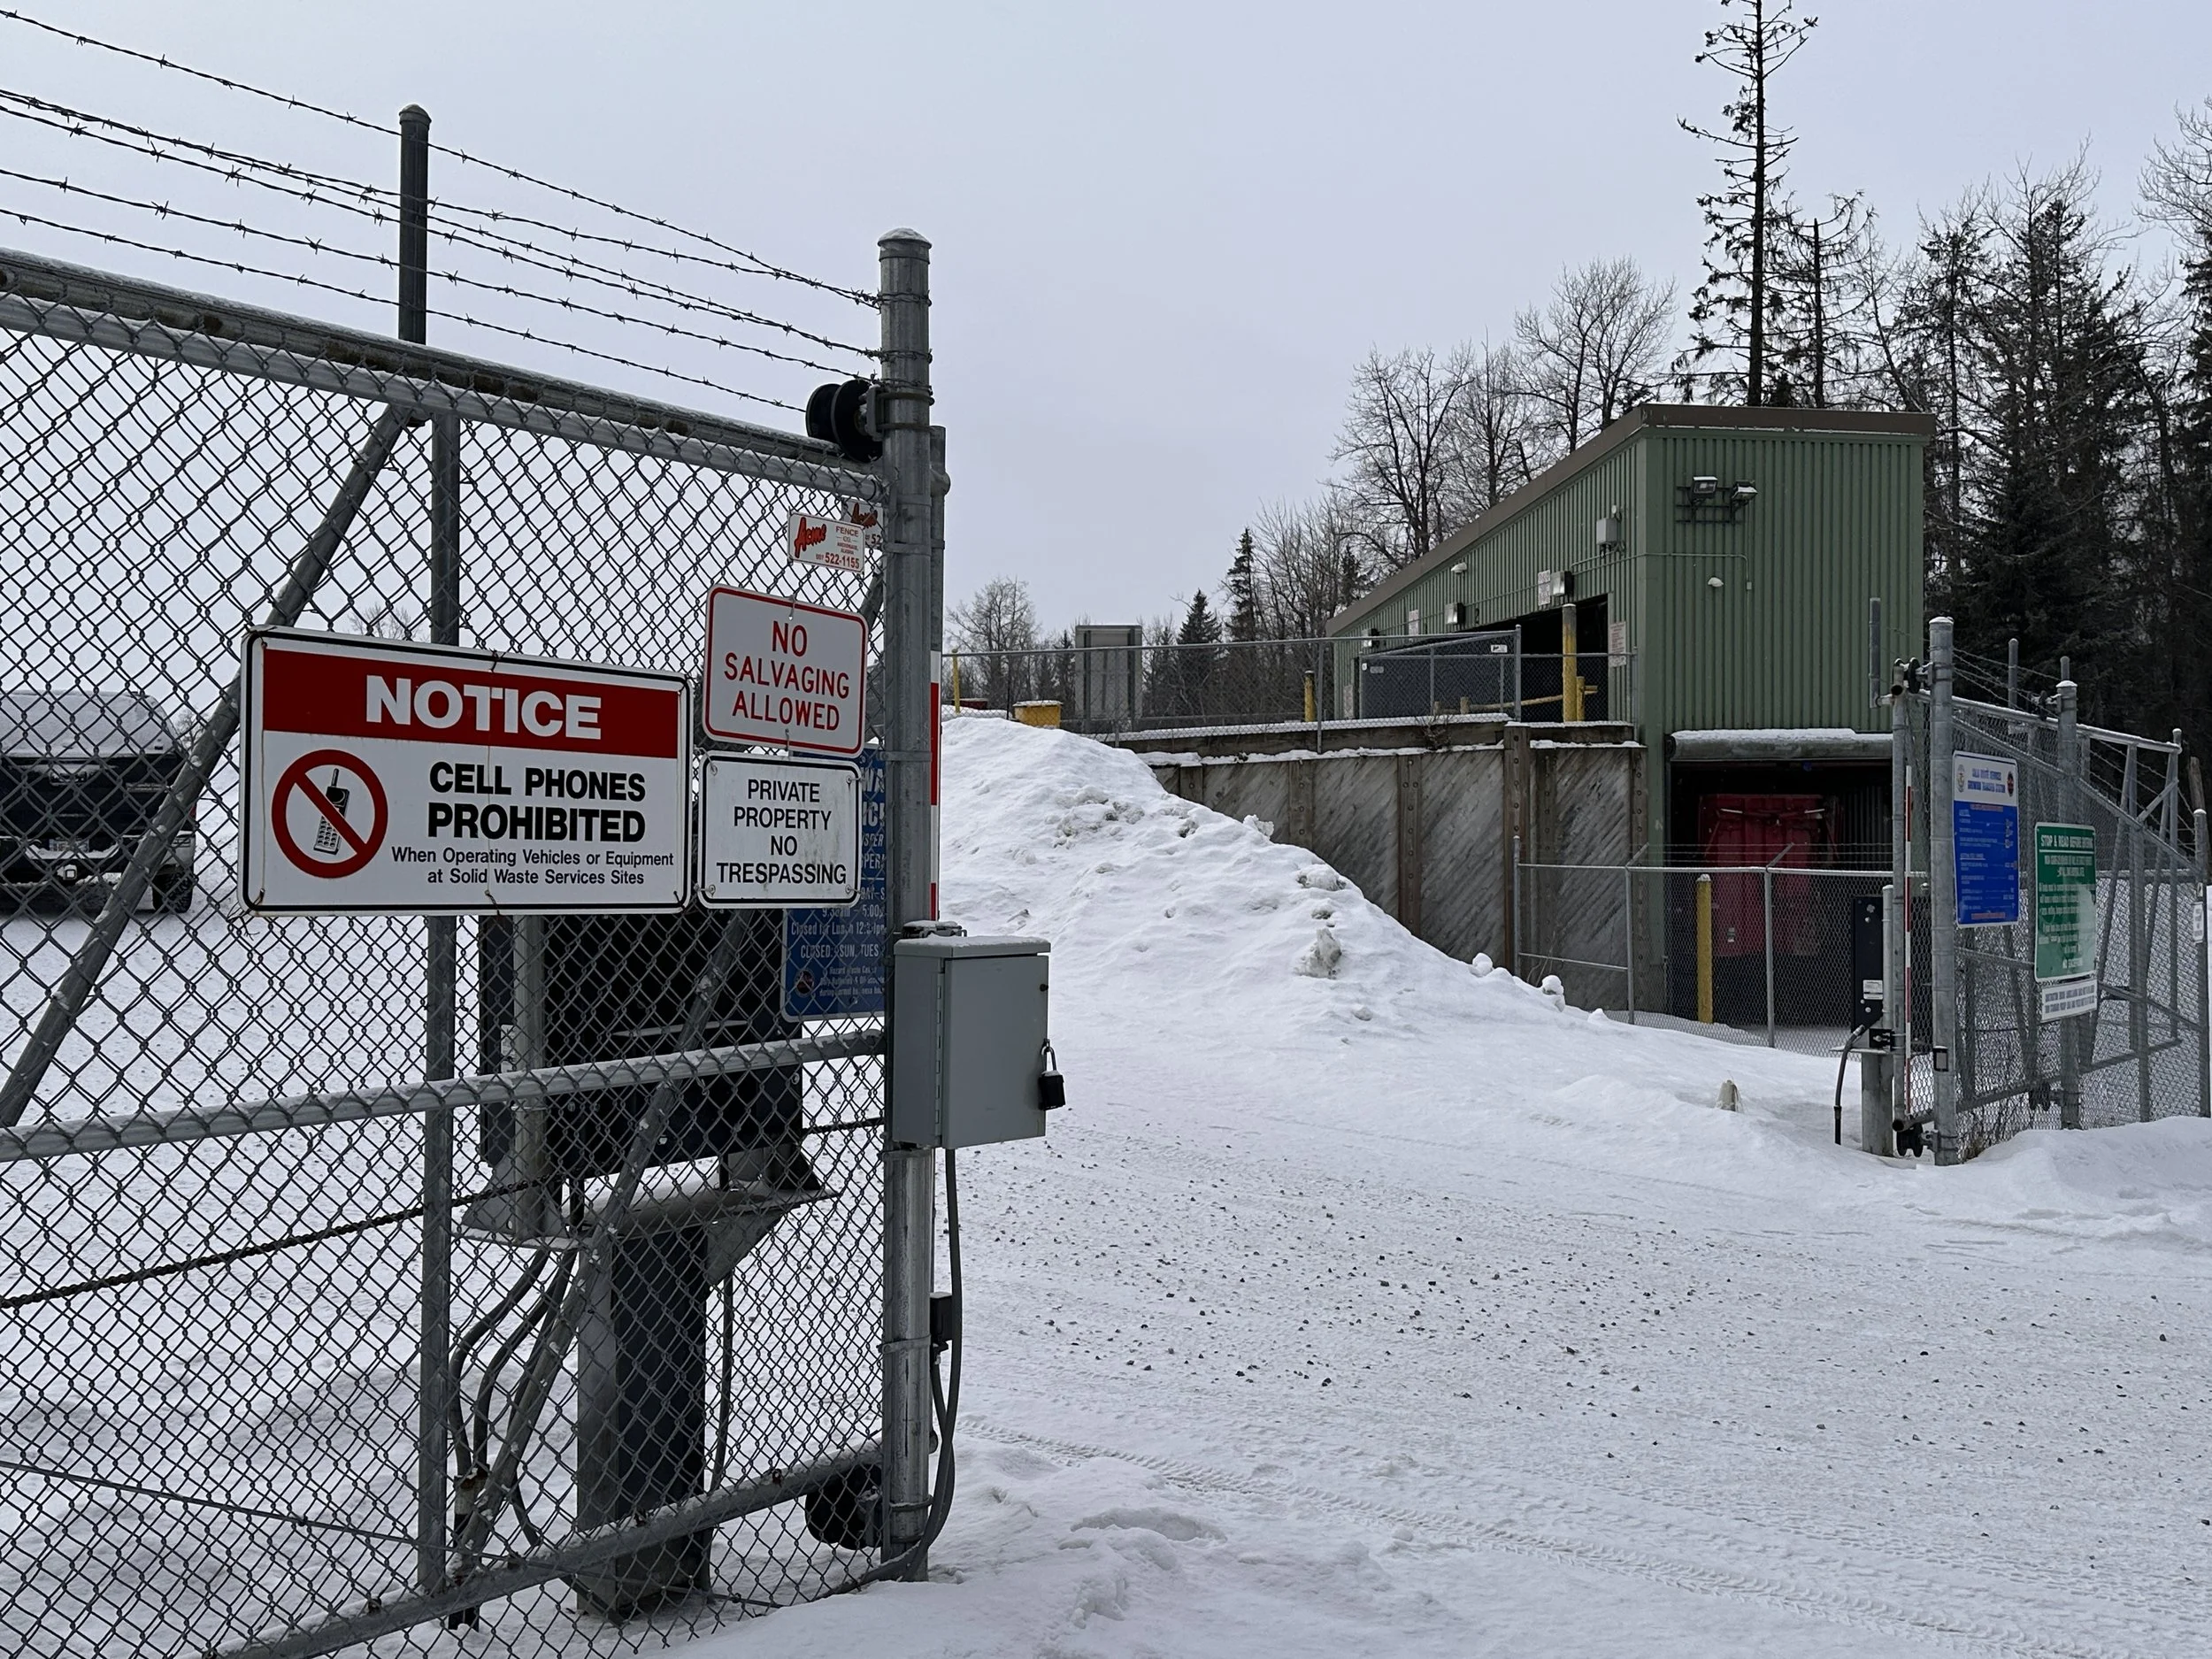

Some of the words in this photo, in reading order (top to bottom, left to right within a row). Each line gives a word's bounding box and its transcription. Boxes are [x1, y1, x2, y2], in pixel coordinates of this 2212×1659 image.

[836, 526, 858, 537] FENCE
[826, 552, 859, 569] 522-1155
[772, 620, 807, 657] NO
[725, 652, 849, 699] SALVAGING
[366, 674, 601, 739] NOTICE
[733, 691, 840, 731] ALLOWED
[429, 762, 511, 795] CELL
[525, 767, 646, 802] PHONES
[748, 779, 820, 803] PRIVATE
[427, 802, 646, 843] PROHIBITED
[733, 807, 832, 830] PROPERTY
[771, 835, 798, 856] NO
[391, 847, 436, 864] When
[442, 847, 516, 866] Operating
[523, 849, 580, 866] Vehicles
[586, 853, 600, 865] or
[606, 851, 674, 869] Equipment
[427, 870, 443, 883] at
[449, 869, 488, 884] Solid
[495, 869, 539, 884] Waste
[544, 869, 605, 885] Services
[611, 871, 644, 885] Sites
[717, 863, 847, 884] TRESPASSING
